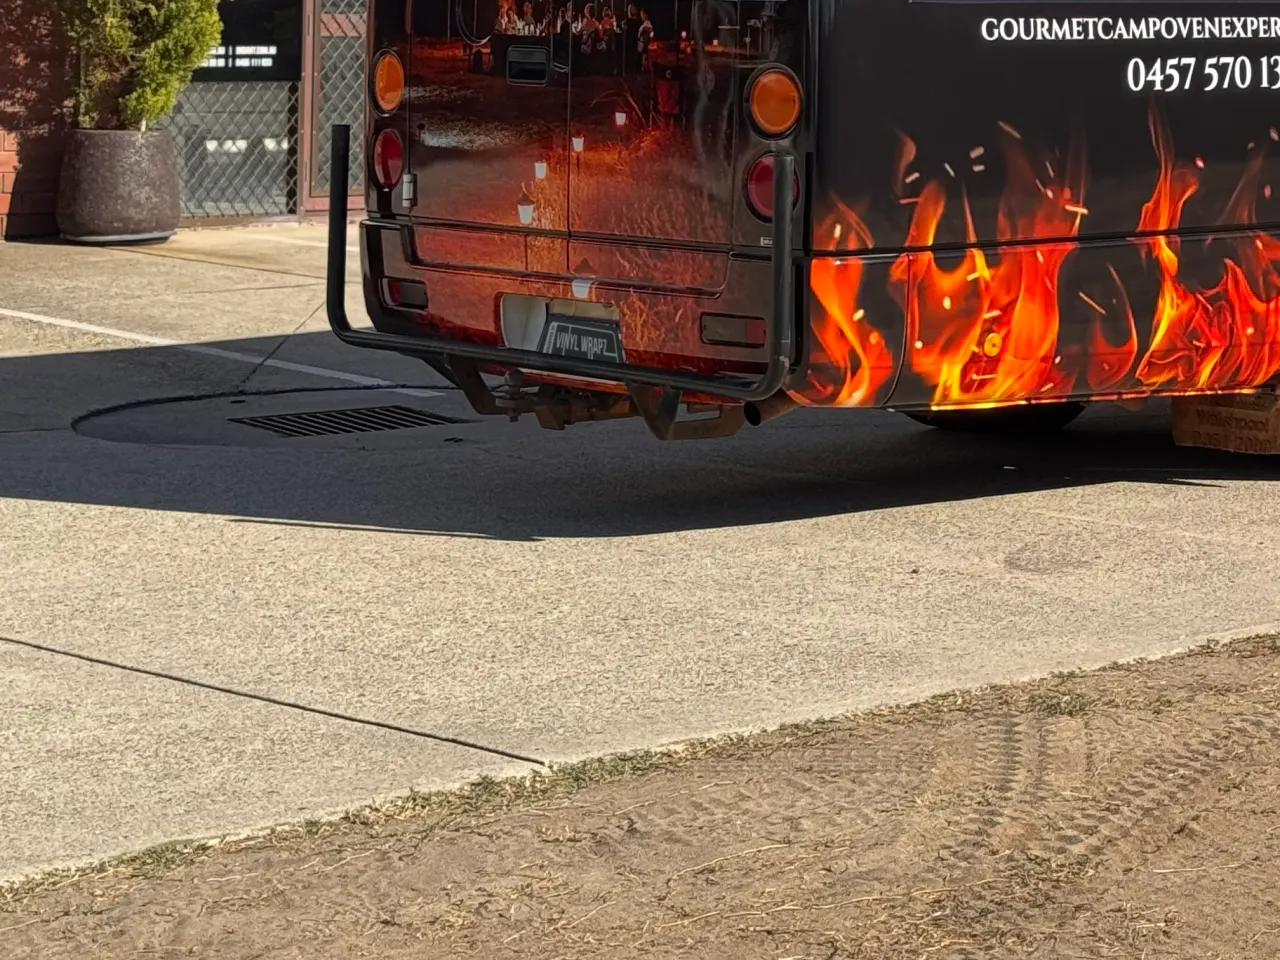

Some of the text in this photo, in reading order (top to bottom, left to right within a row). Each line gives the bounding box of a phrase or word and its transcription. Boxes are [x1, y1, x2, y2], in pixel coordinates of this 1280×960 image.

[1127, 56, 1196, 91] 0457
[1203, 55, 1252, 91] 570
[556, 328, 579, 354] VINYL
[581, 335, 608, 359] WRAPZ
